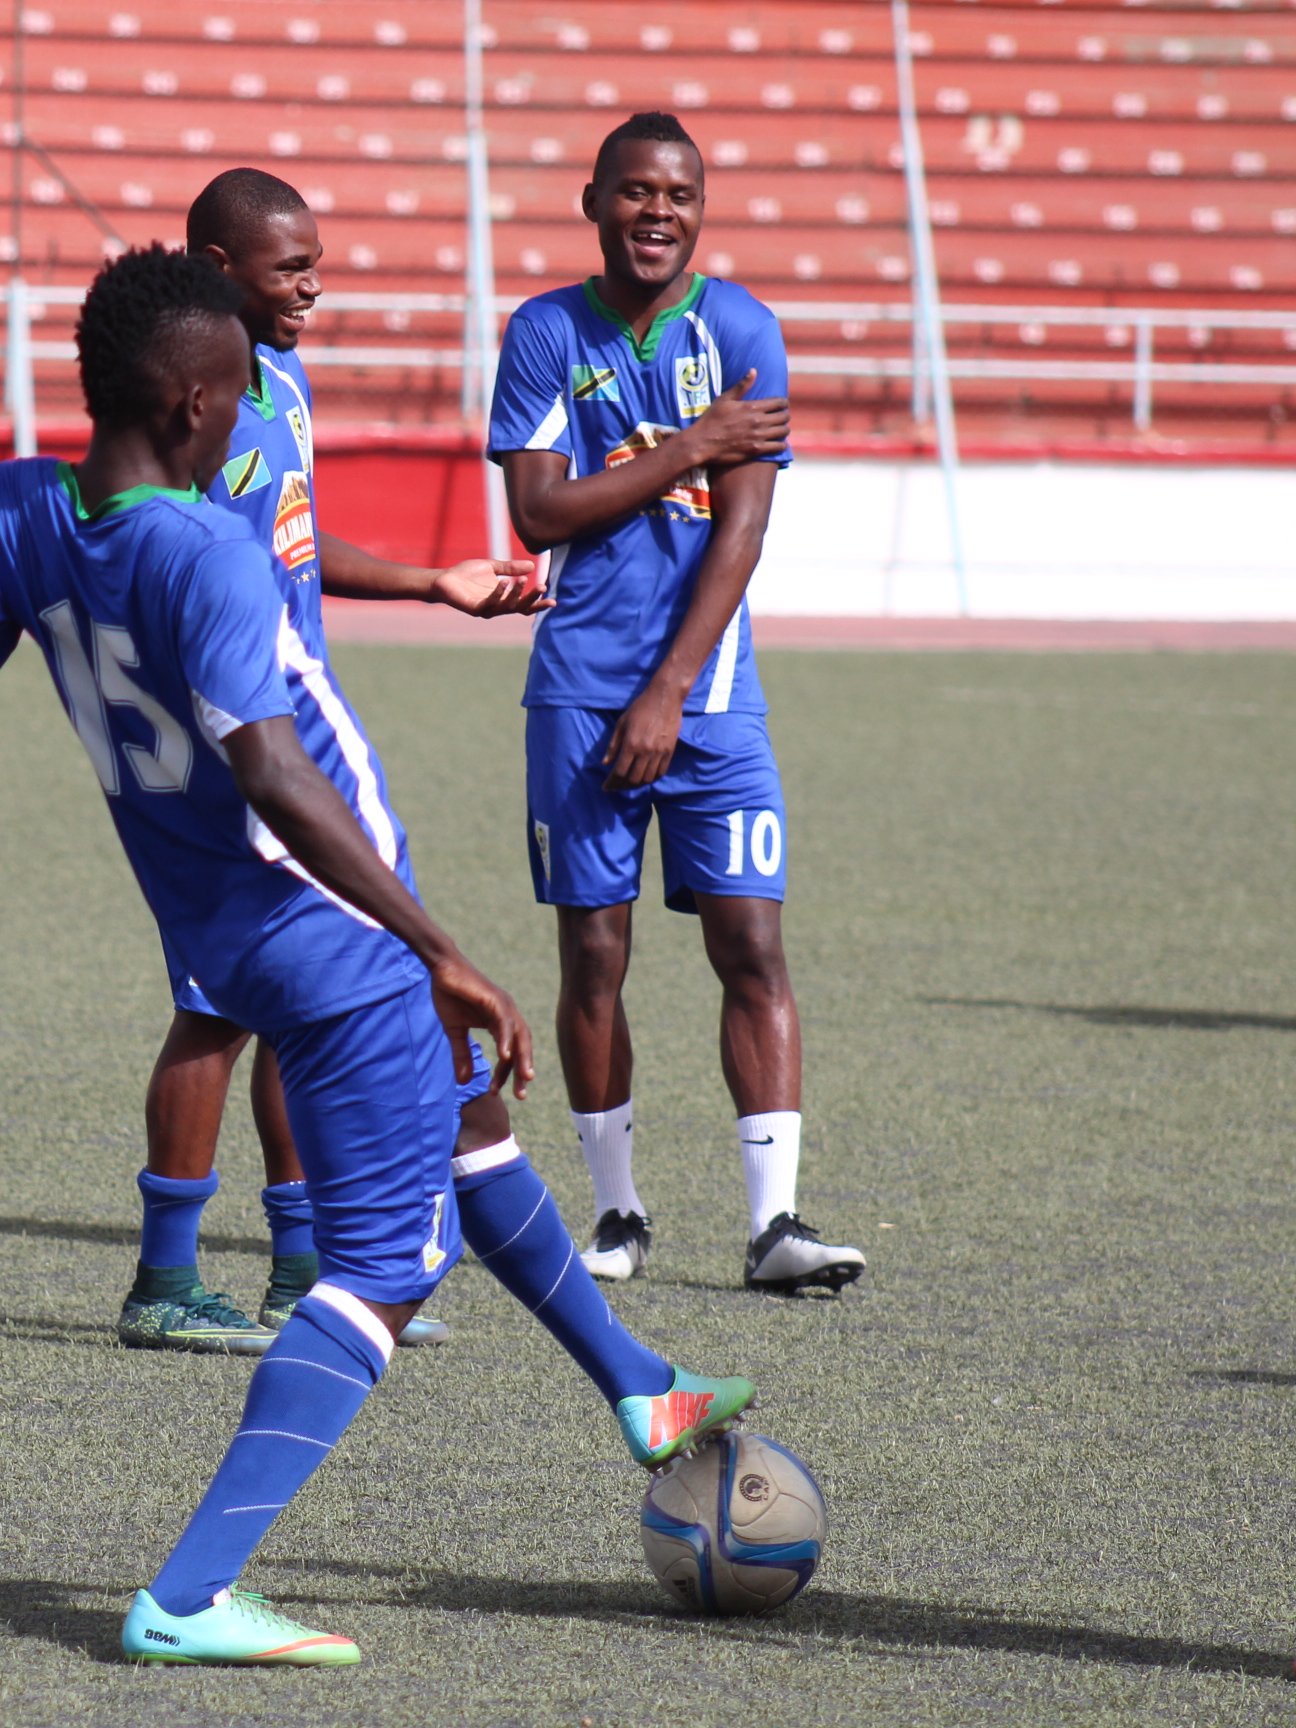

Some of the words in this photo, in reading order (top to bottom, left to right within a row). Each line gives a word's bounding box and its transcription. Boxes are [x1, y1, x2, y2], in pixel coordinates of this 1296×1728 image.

[39, 599, 194, 795] 15
[725, 809, 782, 877] 10
[648, 1391, 715, 1449] NIKE
